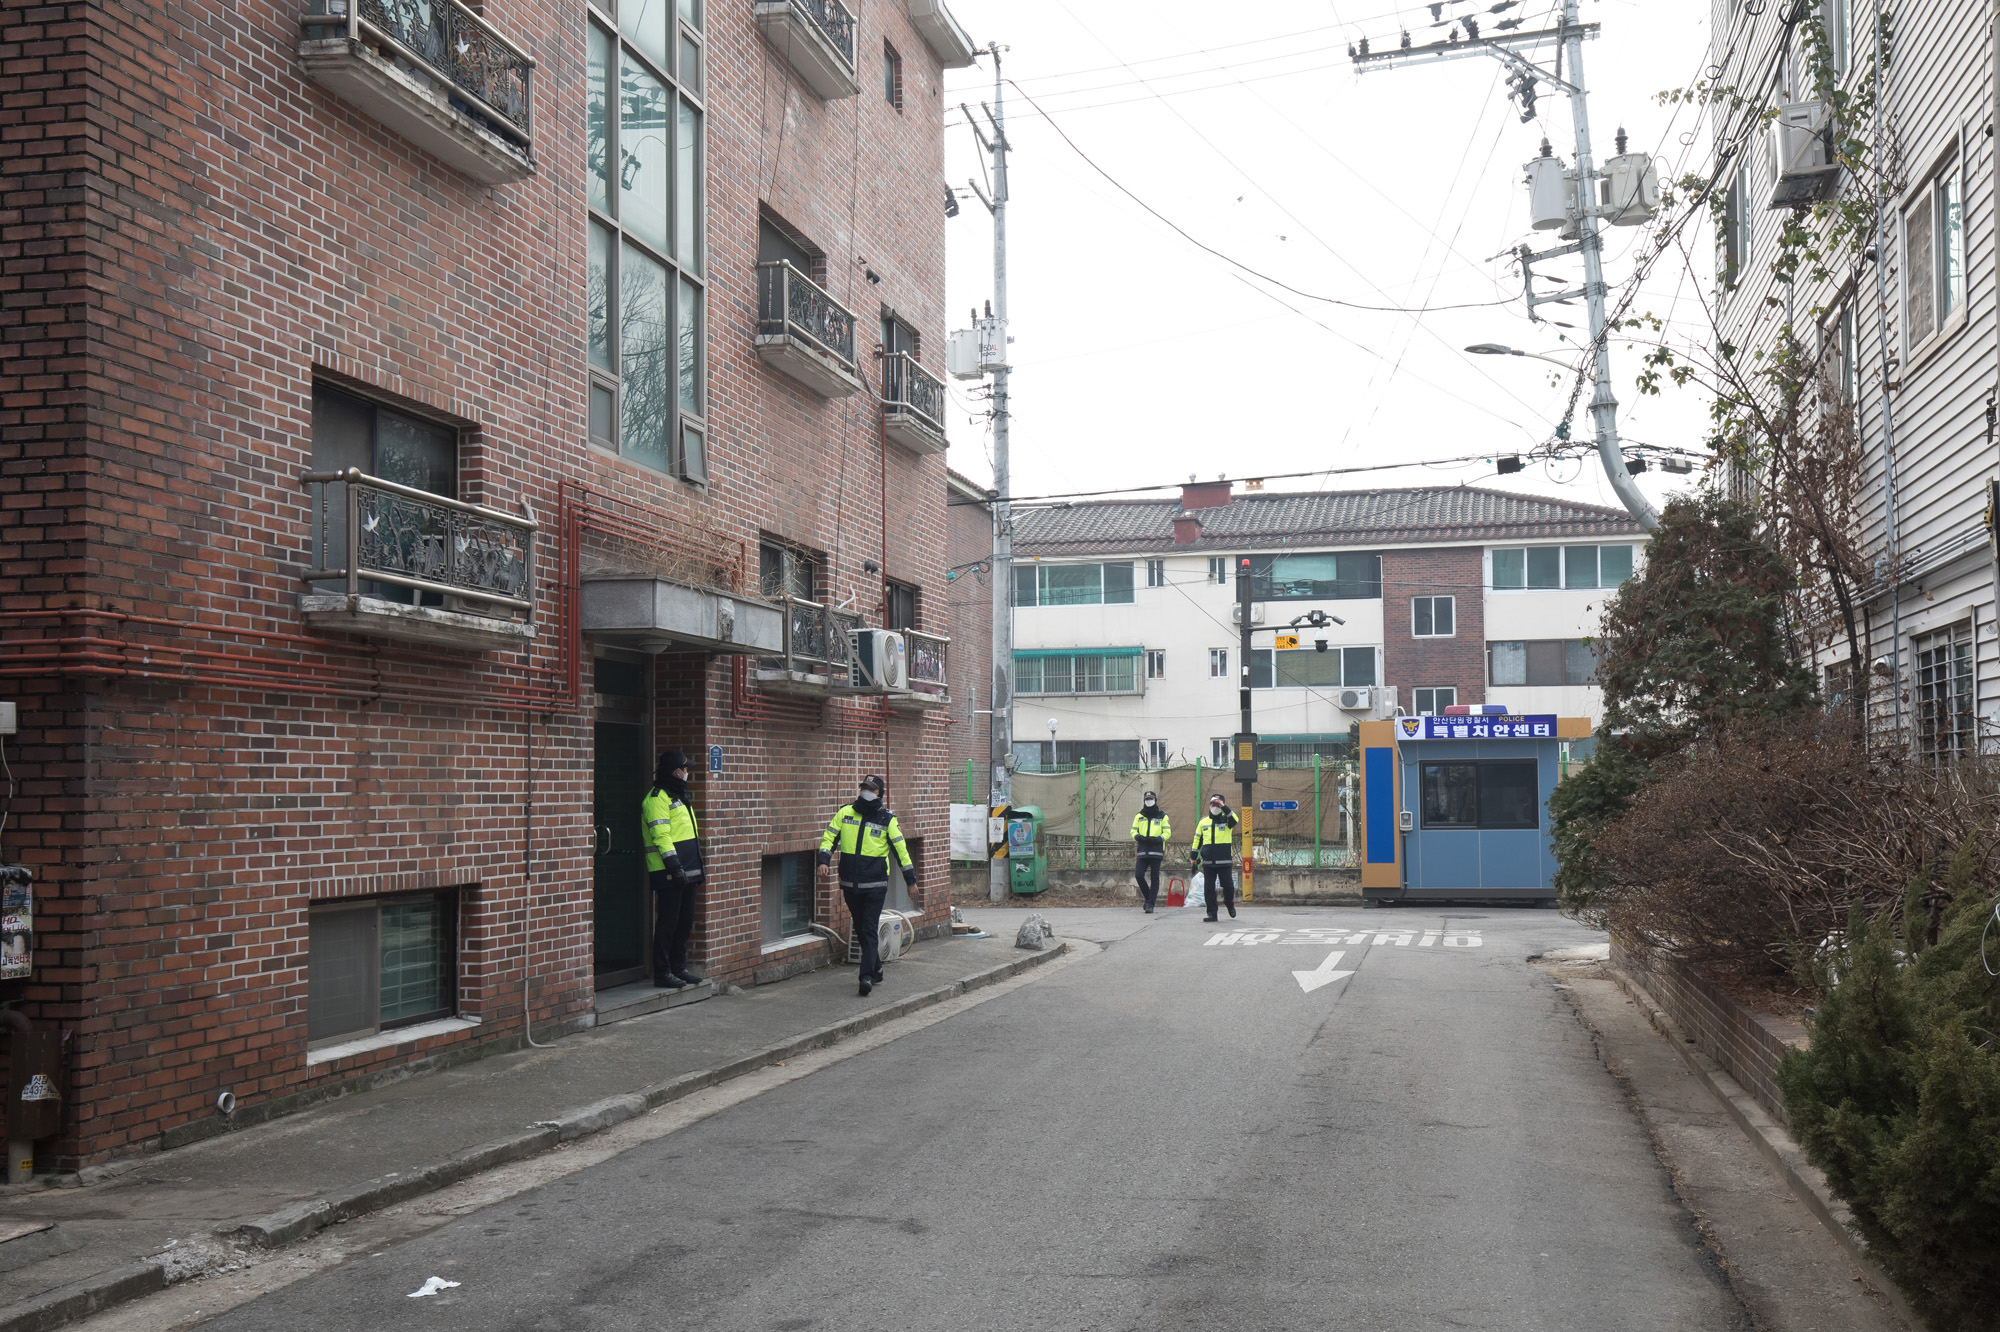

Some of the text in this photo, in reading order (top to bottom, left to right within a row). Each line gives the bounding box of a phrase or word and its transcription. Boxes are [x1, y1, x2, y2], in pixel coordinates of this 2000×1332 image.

[1432, 716, 1489, 725] 안산단원경찰서
[1432, 724, 1550, 738] 특별치안센터
[1203, 927, 1483, 947] 일방통행
